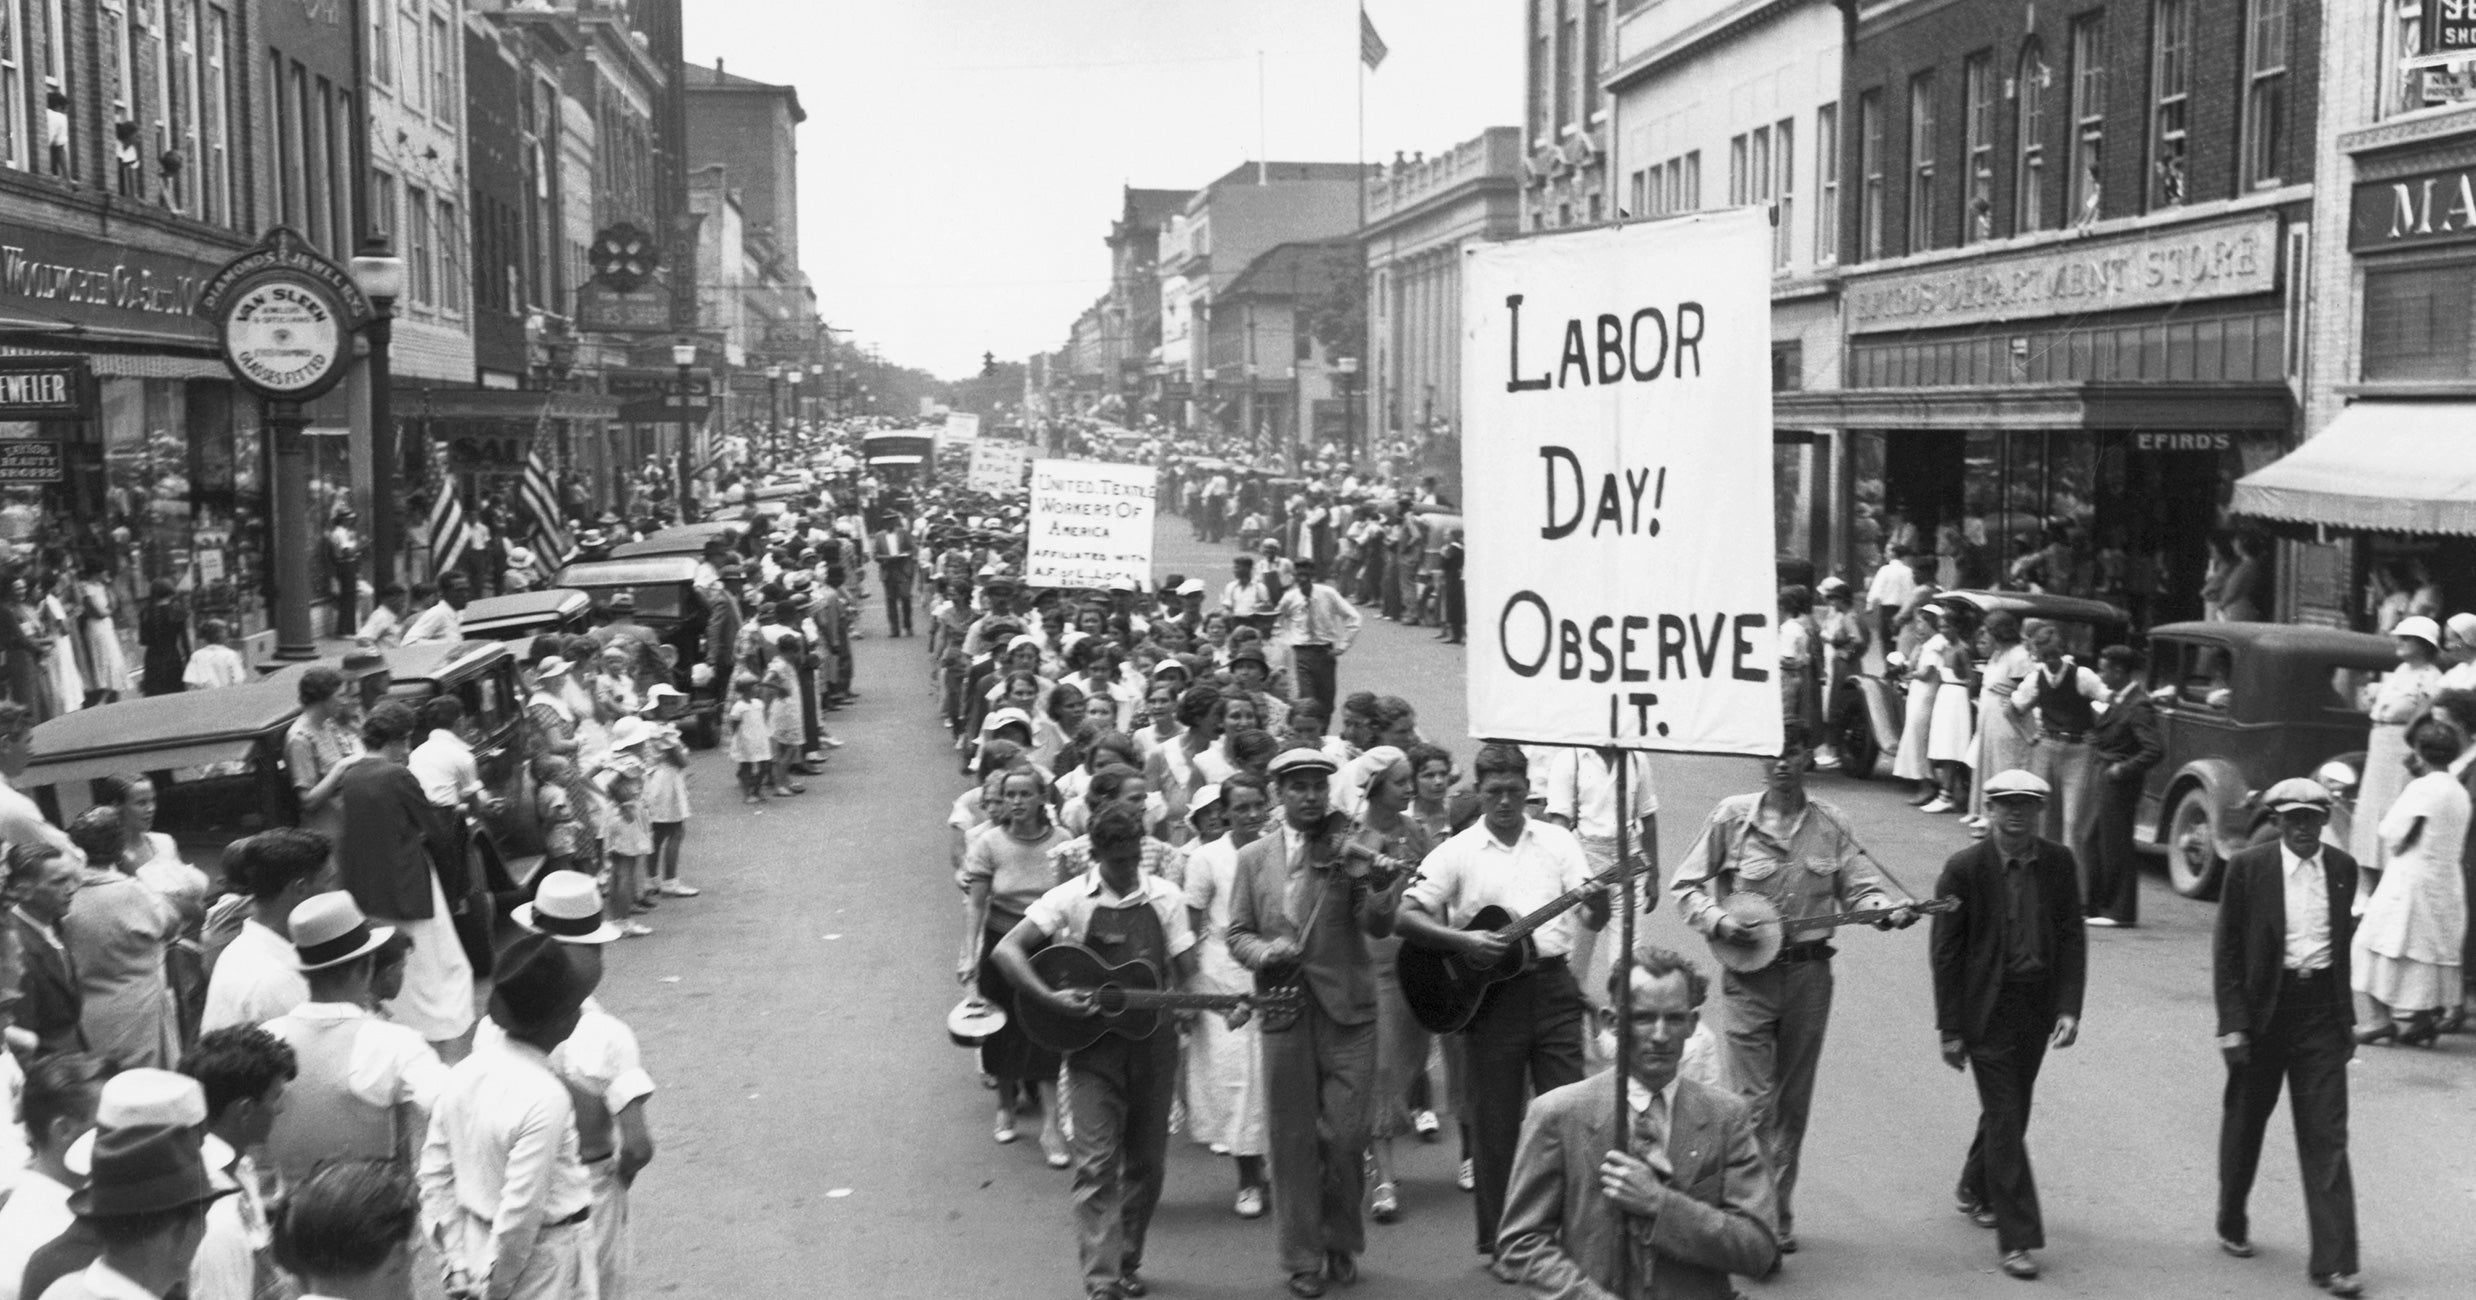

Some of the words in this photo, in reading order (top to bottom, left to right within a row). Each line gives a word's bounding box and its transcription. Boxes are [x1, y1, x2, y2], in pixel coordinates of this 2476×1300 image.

[203, 250, 277, 308] DIAMONDS
[2145, 236, 2258, 288] STORE
[272, 288, 328, 323] SLEEN
[1505, 293, 1705, 393] LABOR
[1, 456, 57, 467] BEAUTY
[1038, 497, 1111, 517] WORKERS
[1539, 446, 1667, 541] DAY!
[1047, 520, 1110, 538] AMERICA
[1033, 549, 1107, 562] AFFILIATED
[1500, 590, 1770, 683] OBSERVE
[1610, 692, 1670, 740] IT.
